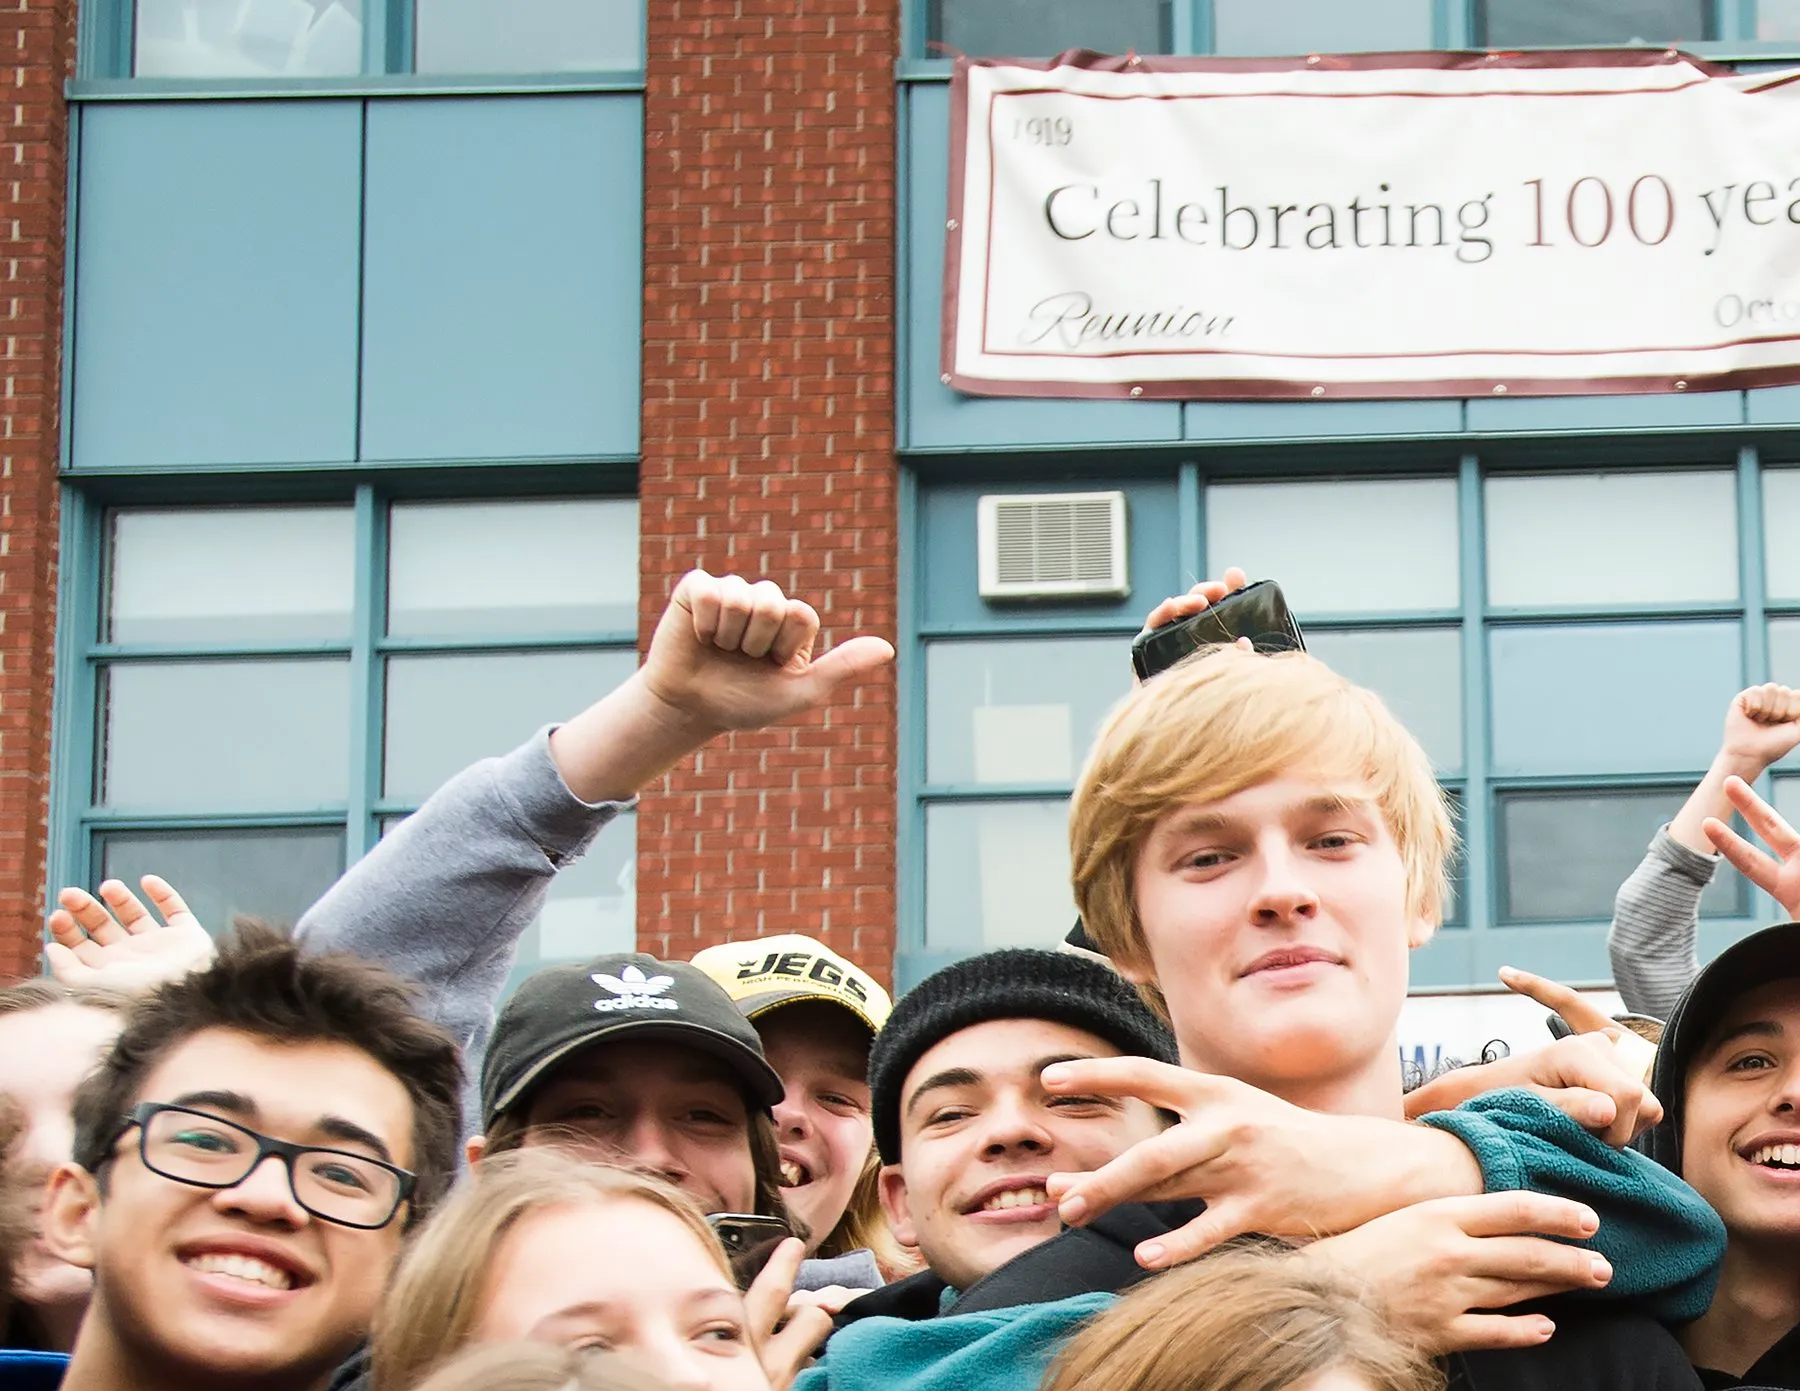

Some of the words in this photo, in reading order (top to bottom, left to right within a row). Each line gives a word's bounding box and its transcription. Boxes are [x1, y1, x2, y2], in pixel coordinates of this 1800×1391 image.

[1012, 116, 1073, 146] 1919
[1045, 179, 1494, 263] Celebrating
[1523, 175, 1675, 247] 100
[1018, 291, 1236, 350] Reunion
[594, 994, 679, 1011] adidas
[737, 953, 867, 1003] JEGS
